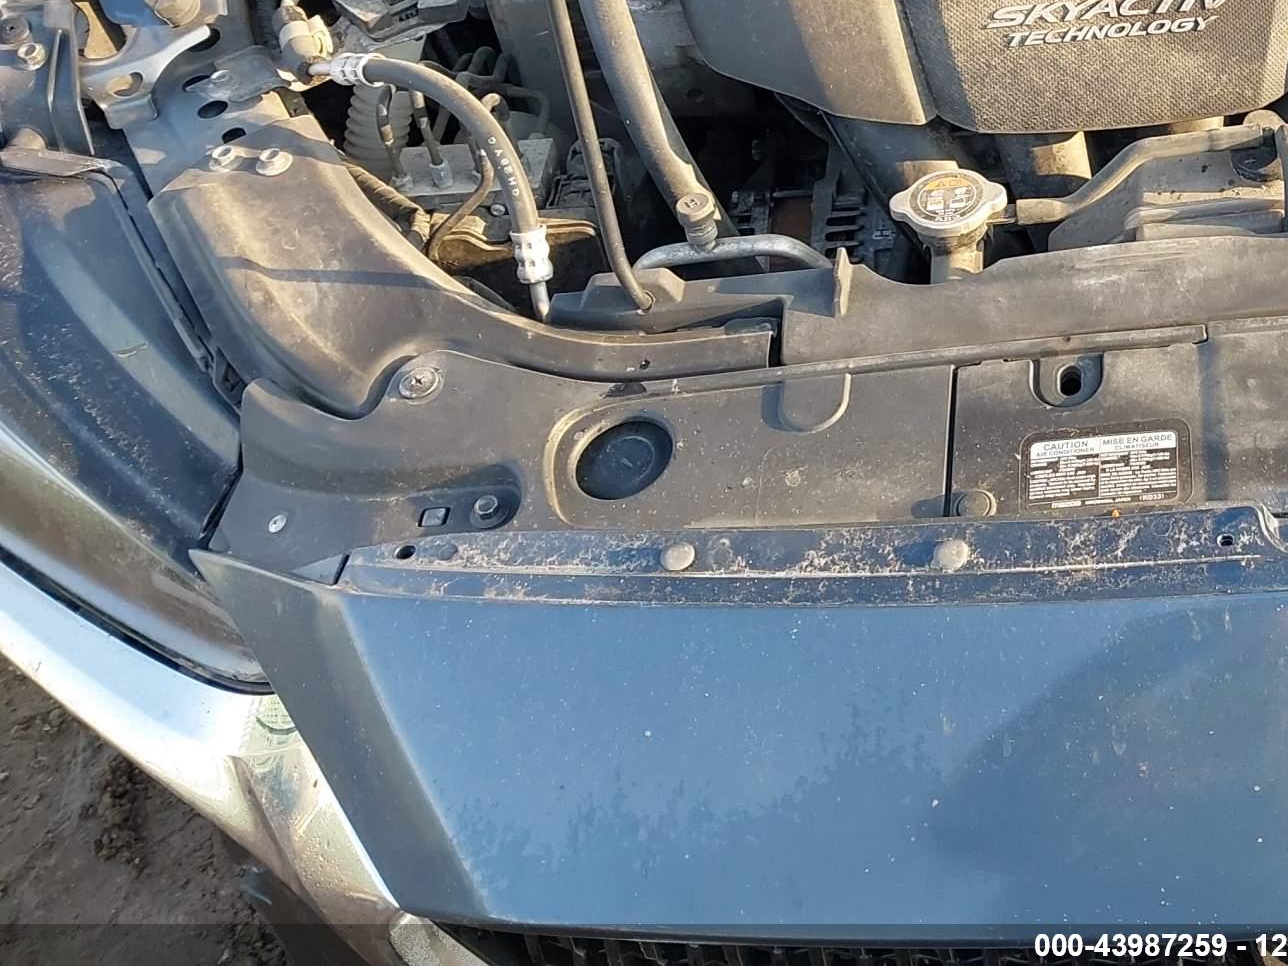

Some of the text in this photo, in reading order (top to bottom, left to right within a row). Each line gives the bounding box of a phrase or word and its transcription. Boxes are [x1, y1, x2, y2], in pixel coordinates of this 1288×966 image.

[1007, 15, 1219, 48] TECHNOLOGY
[1102, 433, 1173, 446] MISE EN GARDE
[1043, 440, 1088, 451] CAUTION
[1114, 442, 1159, 450] CLIMATISEUR
[1048, 447, 1095, 456] CONDITIONER
